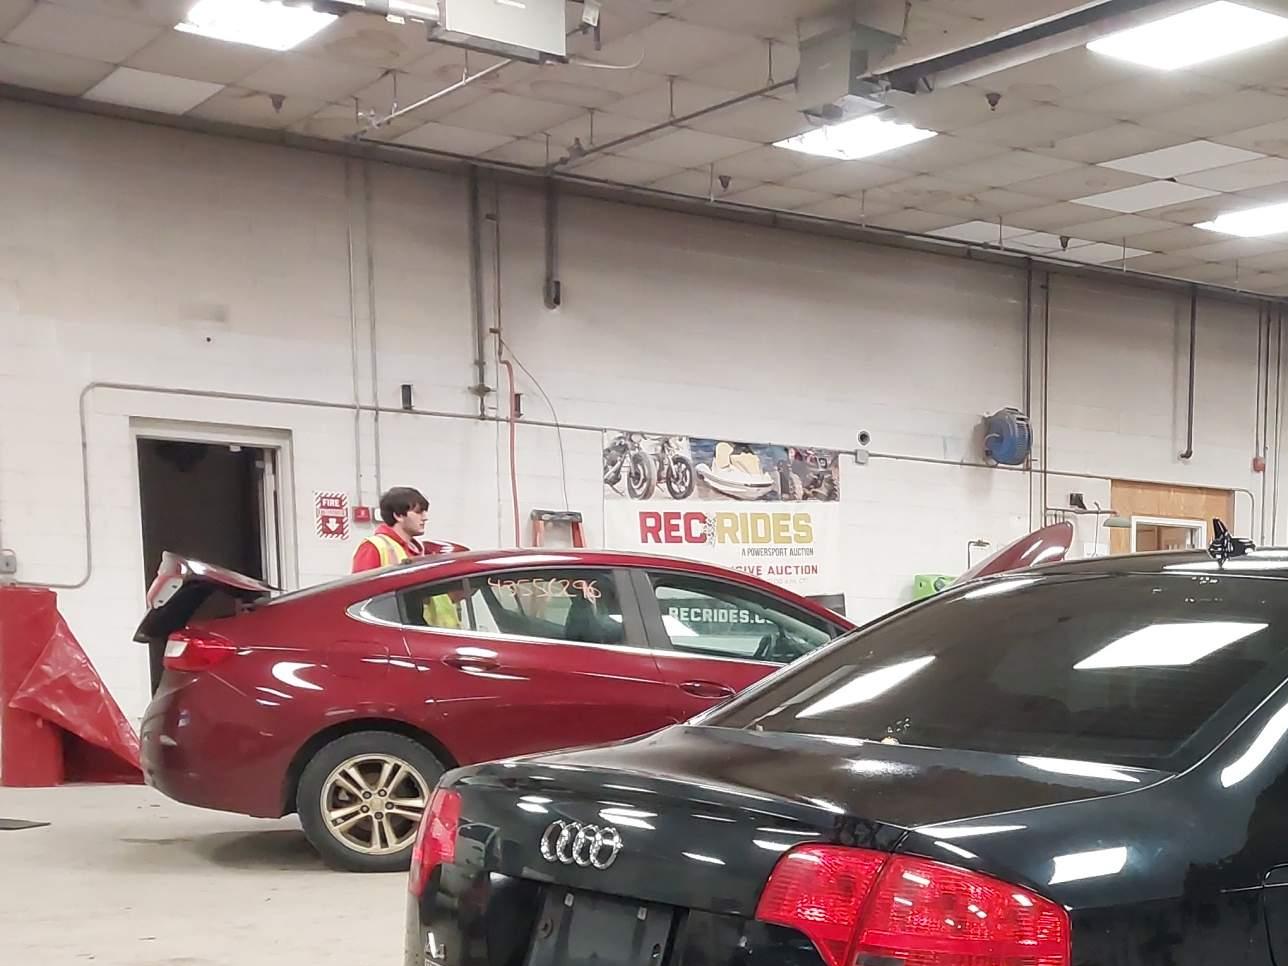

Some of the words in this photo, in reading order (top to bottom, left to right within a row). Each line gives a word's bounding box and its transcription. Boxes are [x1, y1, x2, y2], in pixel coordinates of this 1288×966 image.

[322, 498, 341, 507] FIRE
[639, 511, 707, 544] REC
[715, 511, 814, 544] RIDES
[741, 548, 746, 556] A
[747, 547, 787, 557] POWERSPORT
[789, 547, 814, 556] AUCTION
[768, 564, 818, 576] AUCTION
